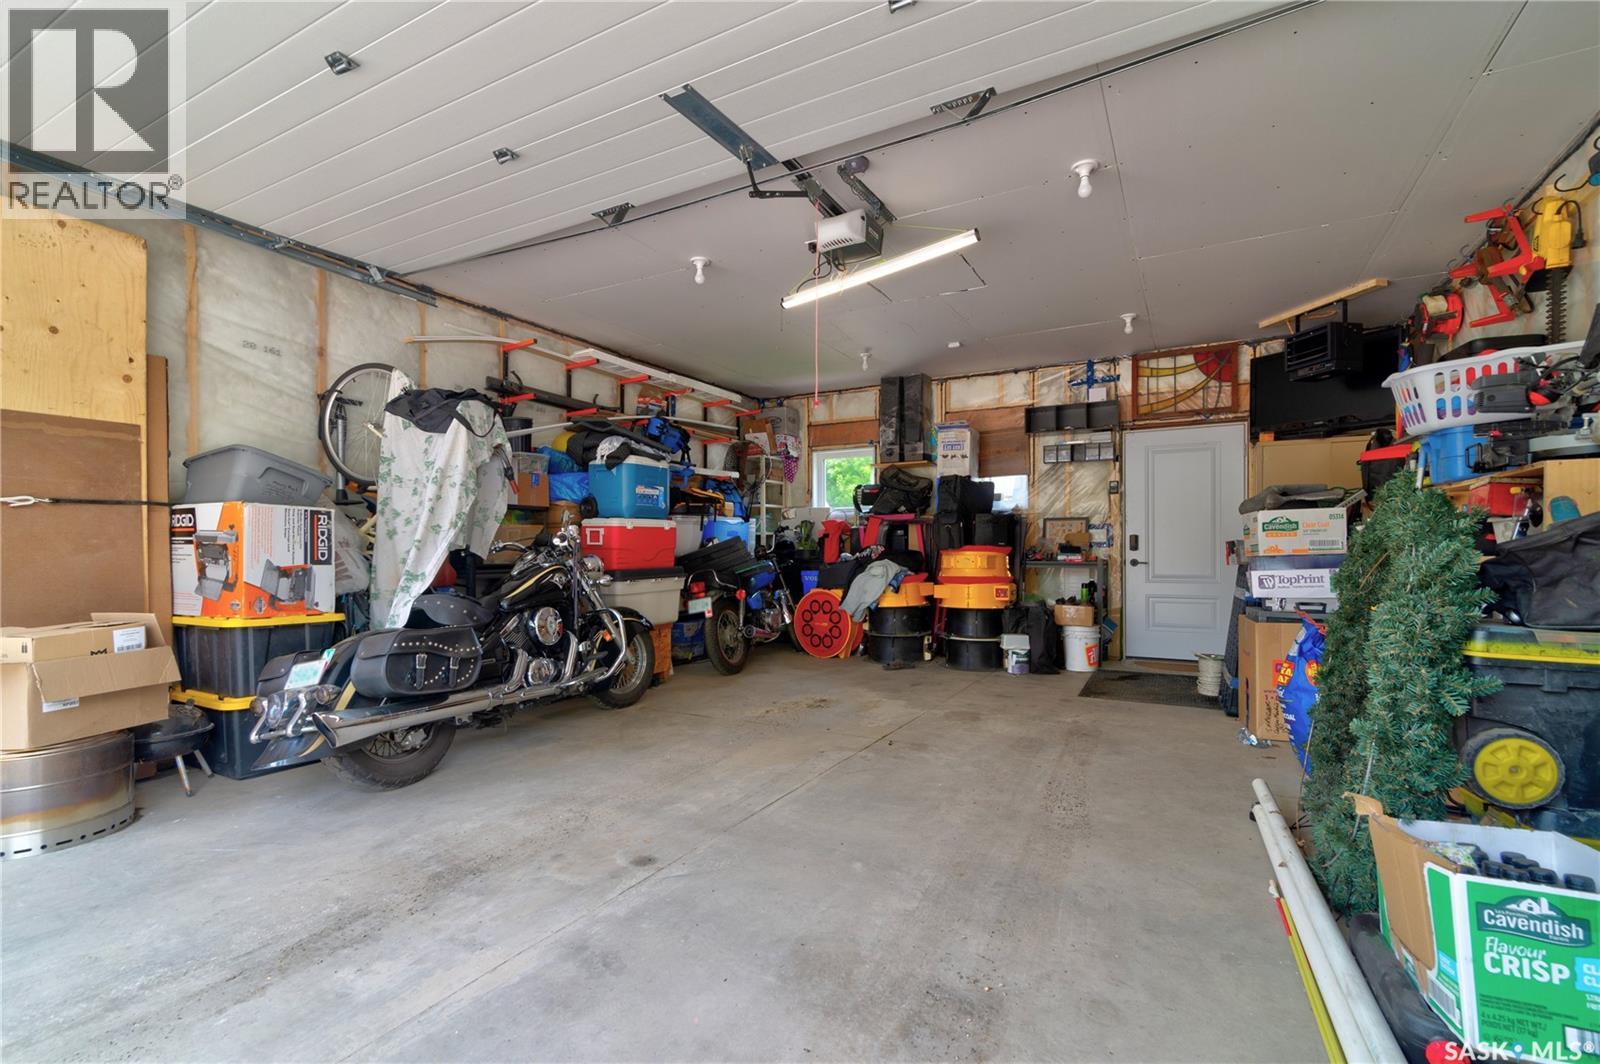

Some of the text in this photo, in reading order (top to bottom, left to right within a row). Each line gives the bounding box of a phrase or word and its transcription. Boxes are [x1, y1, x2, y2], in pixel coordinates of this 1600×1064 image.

[316, 513, 328, 561] RIDGID
[1263, 523, 1298, 532] Cavendish
[1277, 574, 1325, 586] TopPrint
[1483, 909, 1584, 940] Cavendish
[1485, 936, 1547, 961] Flavour
[1483, 951, 1570, 985] CRISP
